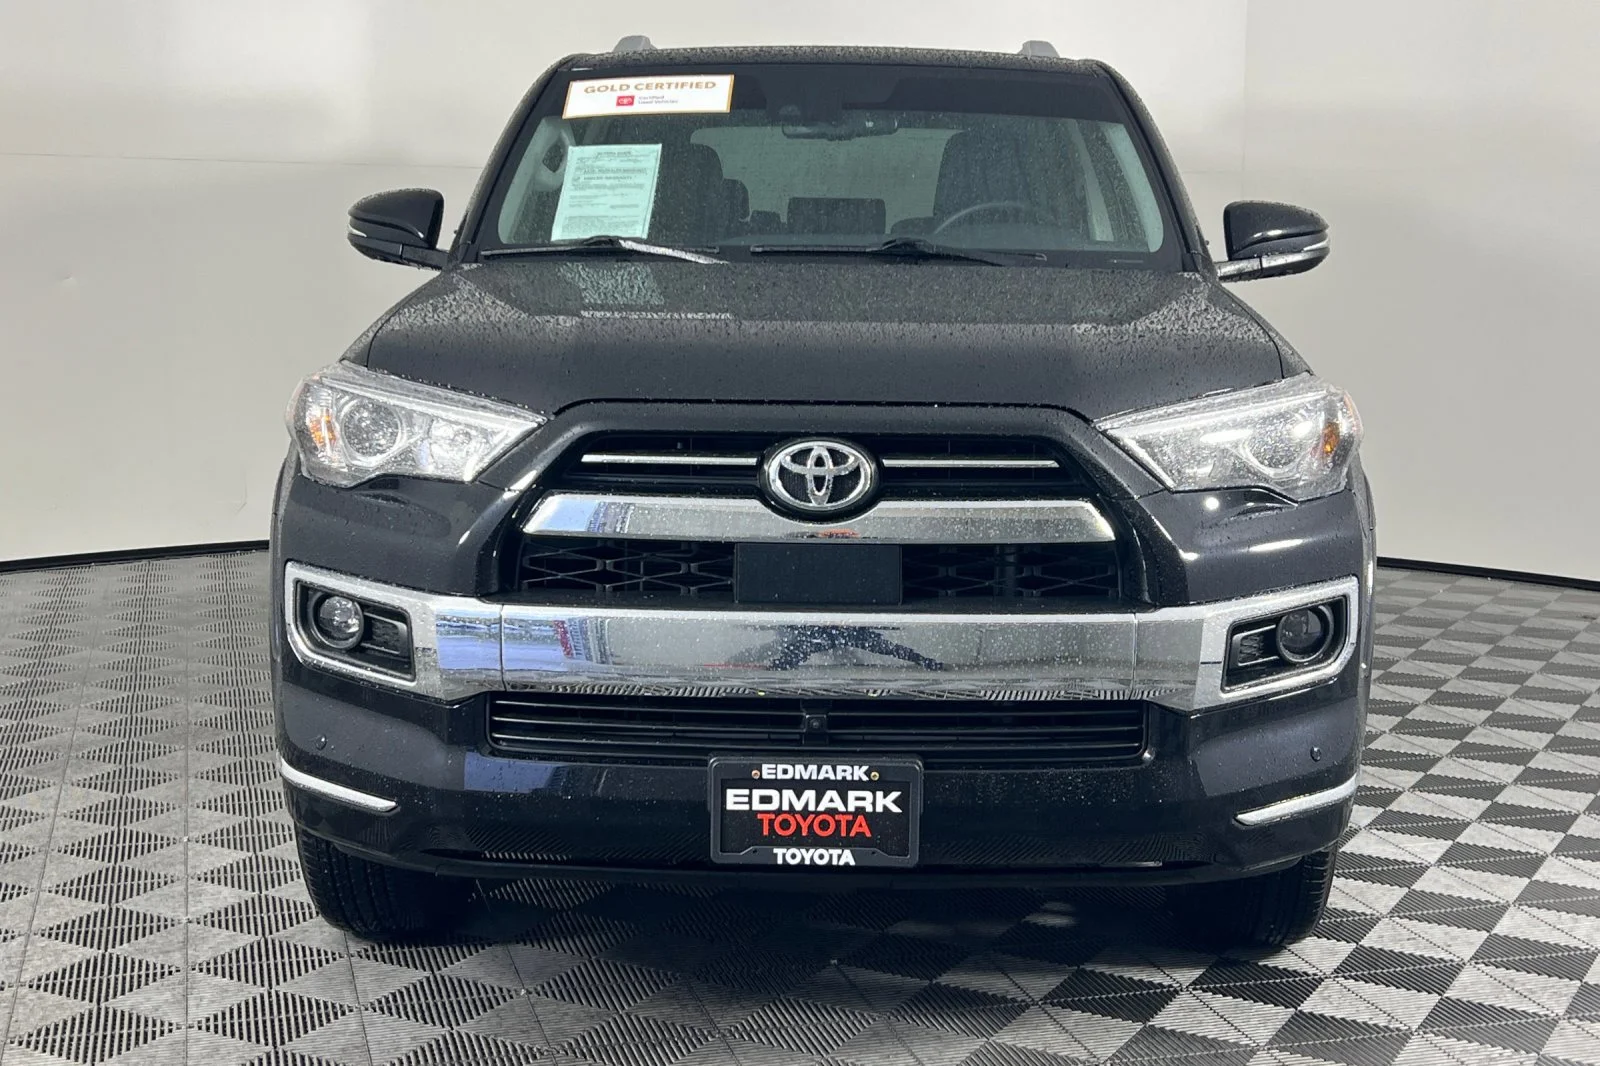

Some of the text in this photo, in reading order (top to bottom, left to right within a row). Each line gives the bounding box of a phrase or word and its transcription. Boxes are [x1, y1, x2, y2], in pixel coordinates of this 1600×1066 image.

[583, 80, 717, 94] GOLD CERTIFIED
[761, 763, 870, 781] EDMARK
[725, 788, 903, 813] EDMARK
[756, 812, 872, 838] TOYOTA
[773, 847, 856, 866] TOYOTA
